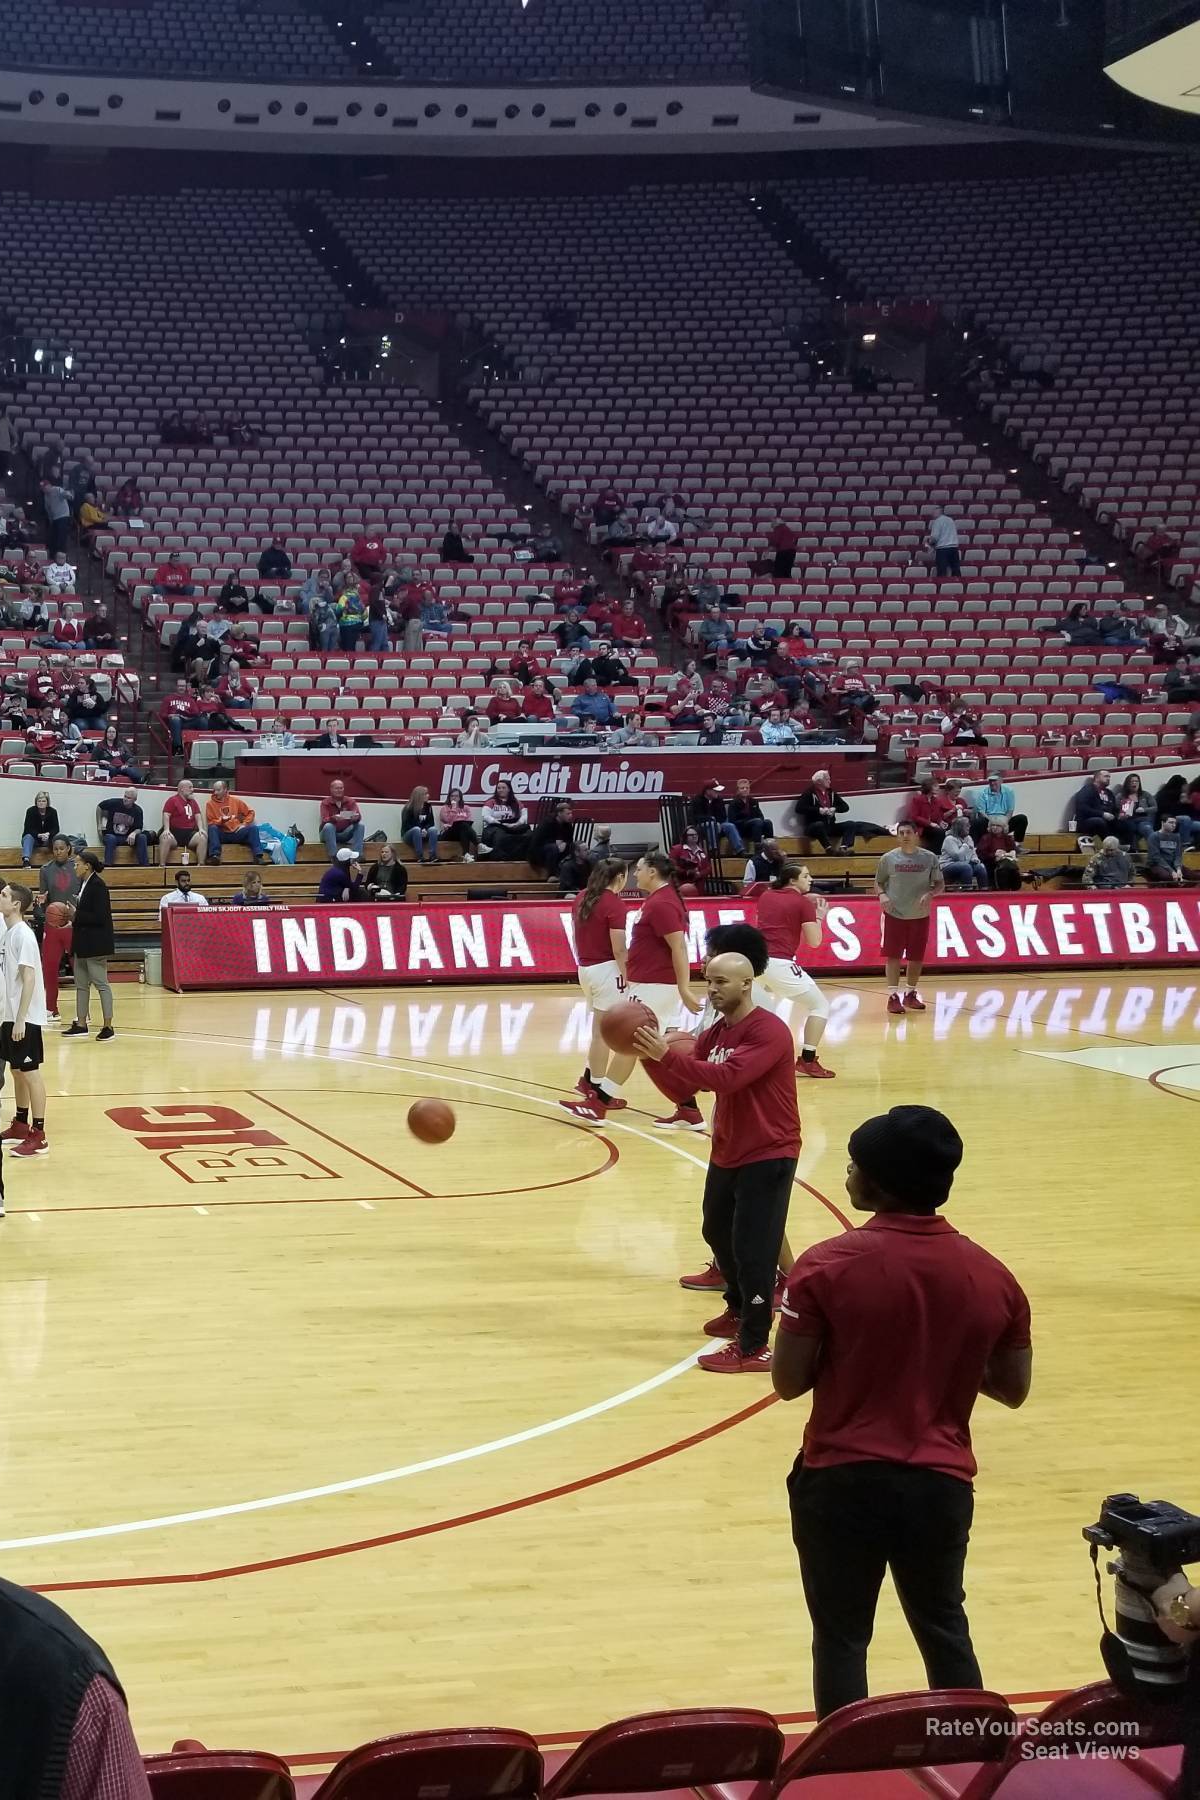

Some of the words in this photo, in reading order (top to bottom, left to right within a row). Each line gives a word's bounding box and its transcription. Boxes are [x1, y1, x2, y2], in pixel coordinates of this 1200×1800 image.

[440, 764, 477, 794] IU
[480, 761, 572, 794] Credit
[578, 760, 665, 794] Union
[251, 913, 536, 973] INDIANA
